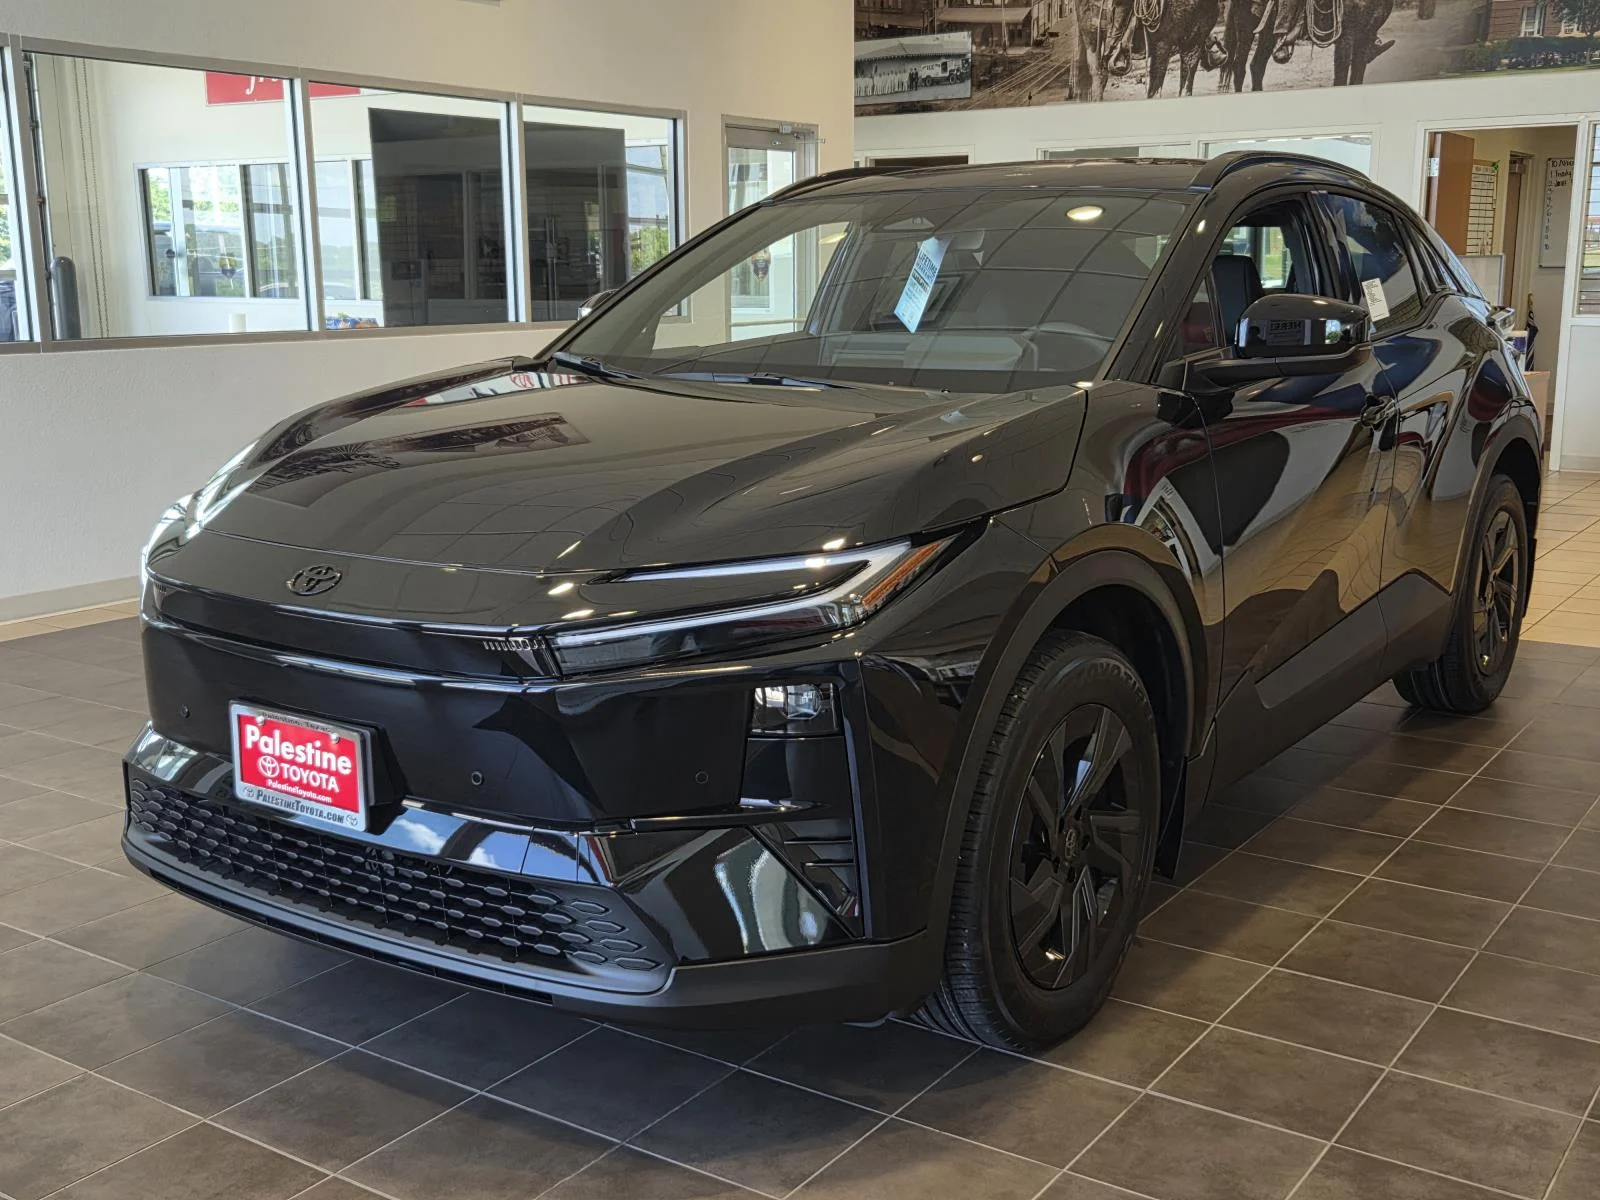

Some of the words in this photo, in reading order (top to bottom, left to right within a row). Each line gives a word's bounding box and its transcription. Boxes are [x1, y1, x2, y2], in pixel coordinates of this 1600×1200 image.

[918, 251, 938, 275] LIFETIME
[244, 723, 353, 775] Palestine
[266, 779, 332, 803] PalestineToyota.com
[280, 762, 340, 793] TOYOTA
